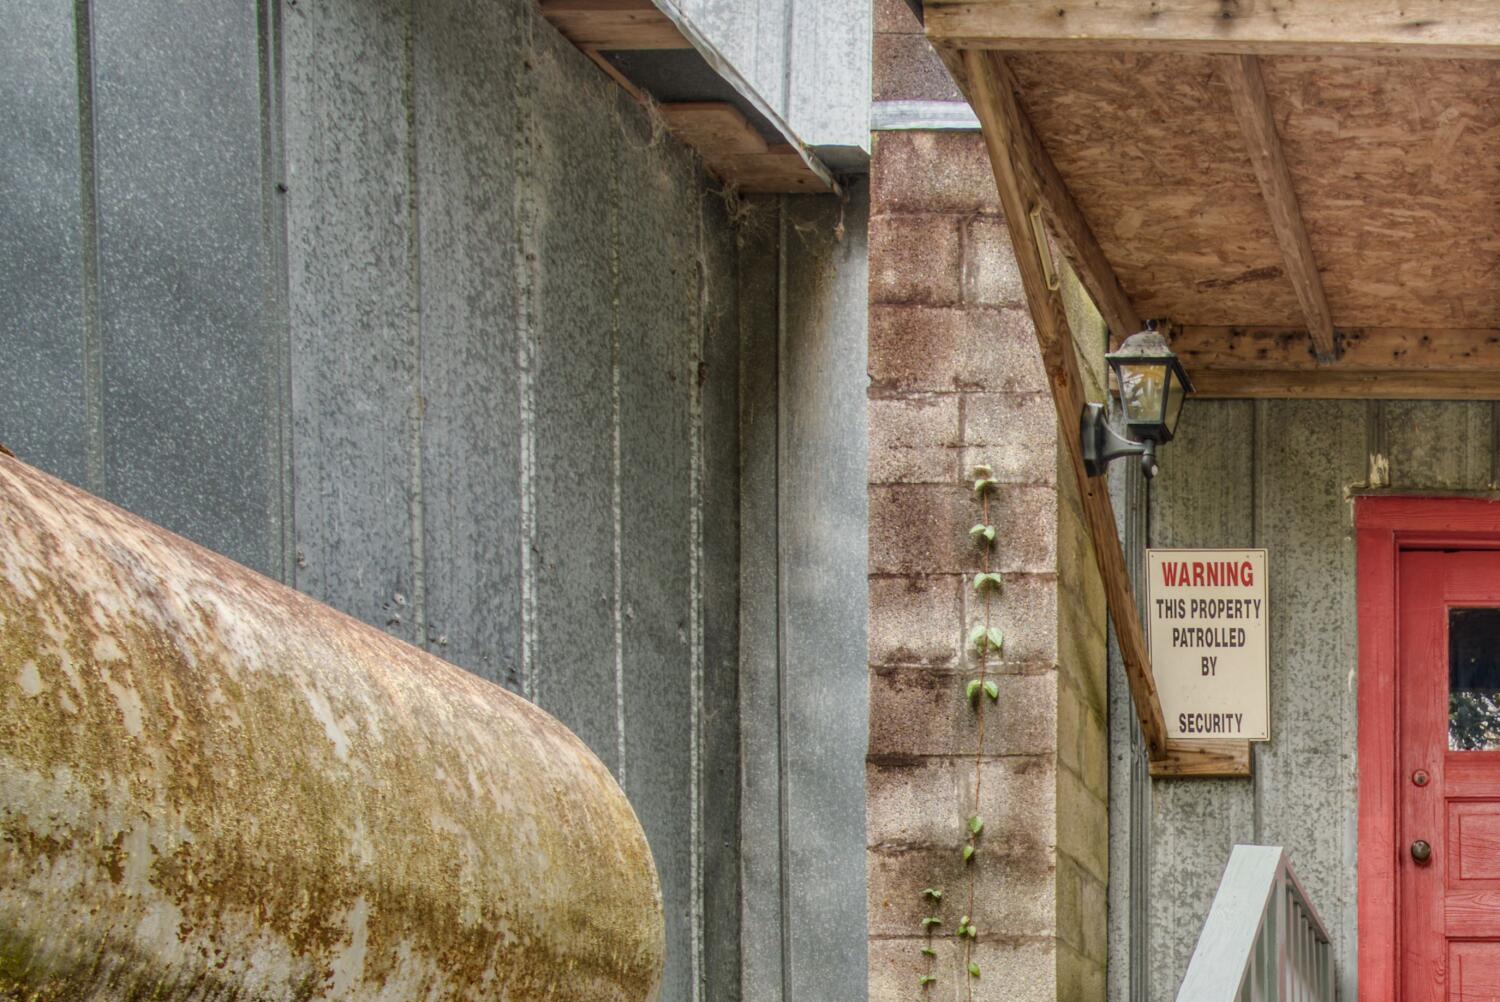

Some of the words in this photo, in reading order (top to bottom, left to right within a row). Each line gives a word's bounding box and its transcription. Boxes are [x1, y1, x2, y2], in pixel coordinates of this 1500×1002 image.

[1162, 561, 1254, 587] WARNING
[1156, 598, 1186, 619] THIS
[1190, 598, 1262, 619] PROPERTY
[1172, 627, 1246, 648] PATROLLED
[1201, 656, 1218, 676] BY
[1178, 713, 1243, 733] SECURITY
